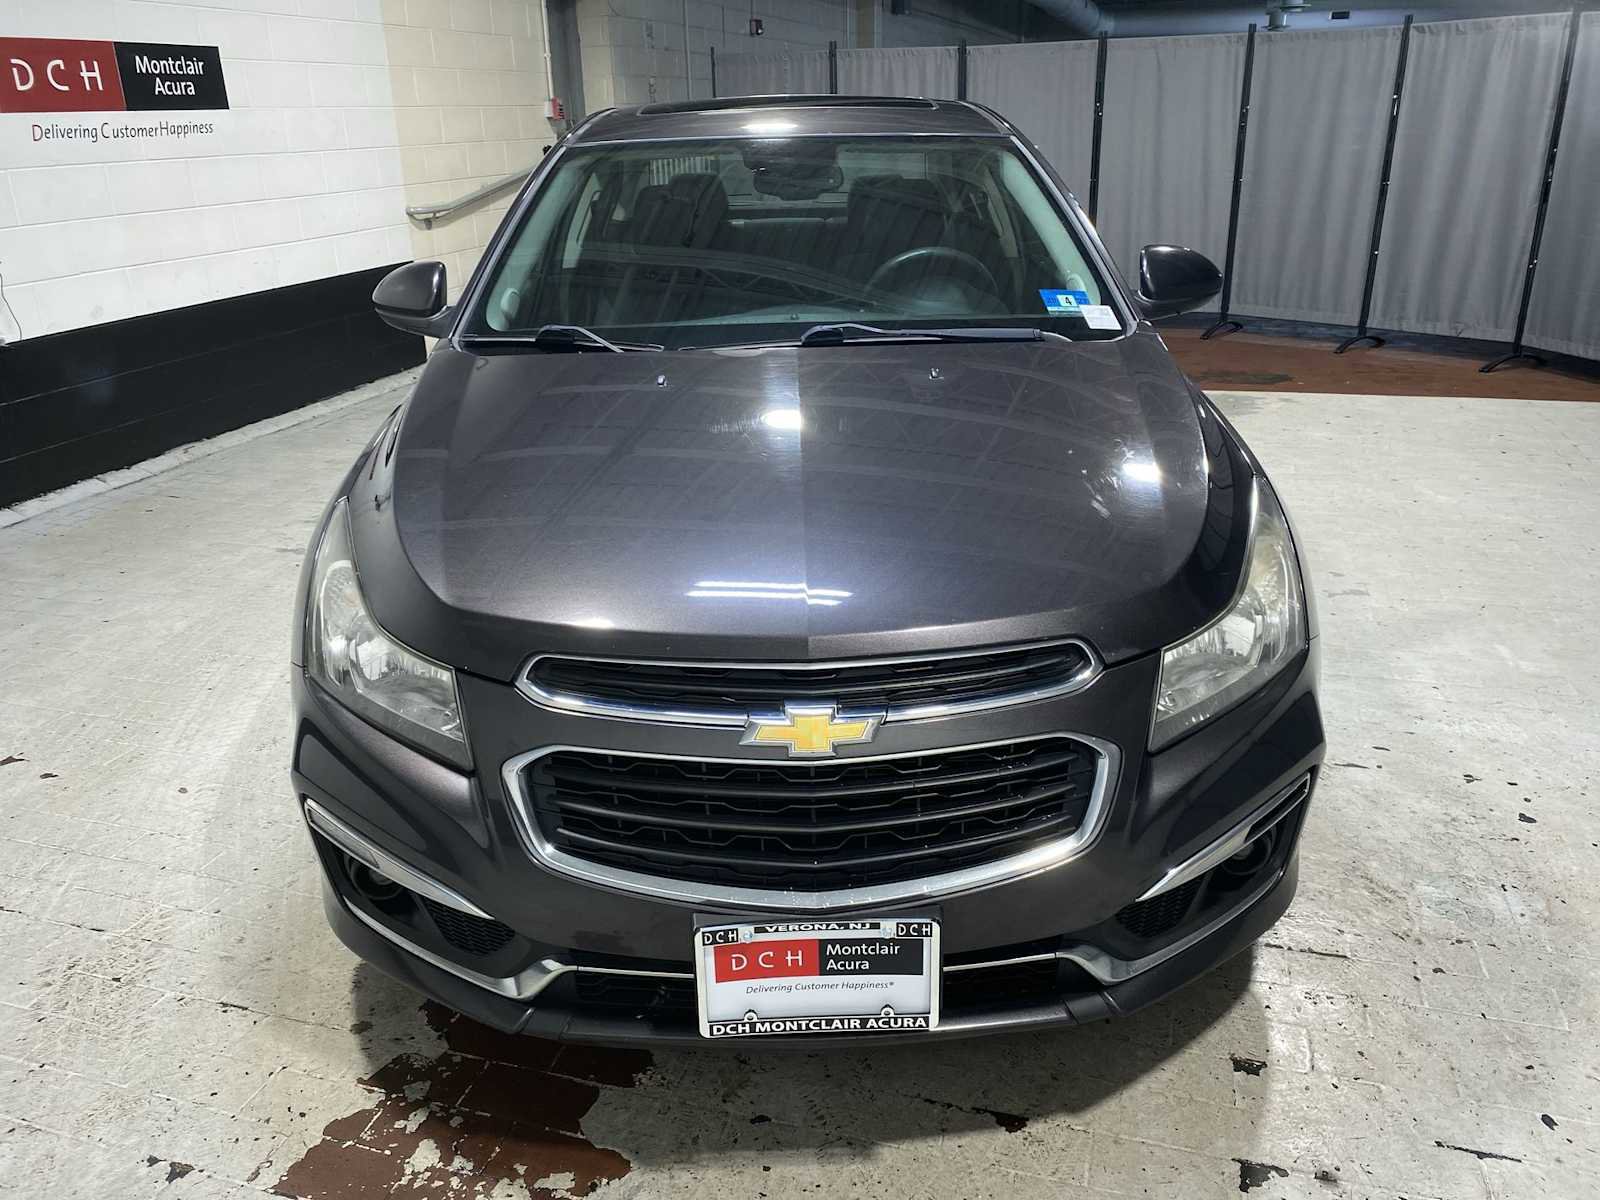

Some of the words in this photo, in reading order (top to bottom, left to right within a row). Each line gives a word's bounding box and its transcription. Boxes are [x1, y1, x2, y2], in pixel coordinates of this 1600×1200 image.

[135, 55, 204, 76] Montclair
[10, 58, 104, 92] DCH
[155, 77, 195, 96] Acura
[32, 123, 98, 143] Delivering
[100, 122, 159, 139] Customer
[159, 121, 214, 138] Happiness
[1065, 296, 1072, 305] 4
[704, 930, 738, 945] DCH
[898, 924, 931, 936] DCH
[826, 943, 900, 956] Montclair
[731, 950, 803, 972] DCH
[826, 957, 870, 972] Acura
[746, 984, 793, 994] Delivering
[795, 982, 838, 991] Customer
[712, 1023, 750, 1036] DCH
[755, 1018, 862, 1034] MONTCLAIR
[868, 1016, 928, 1030] ACURA
